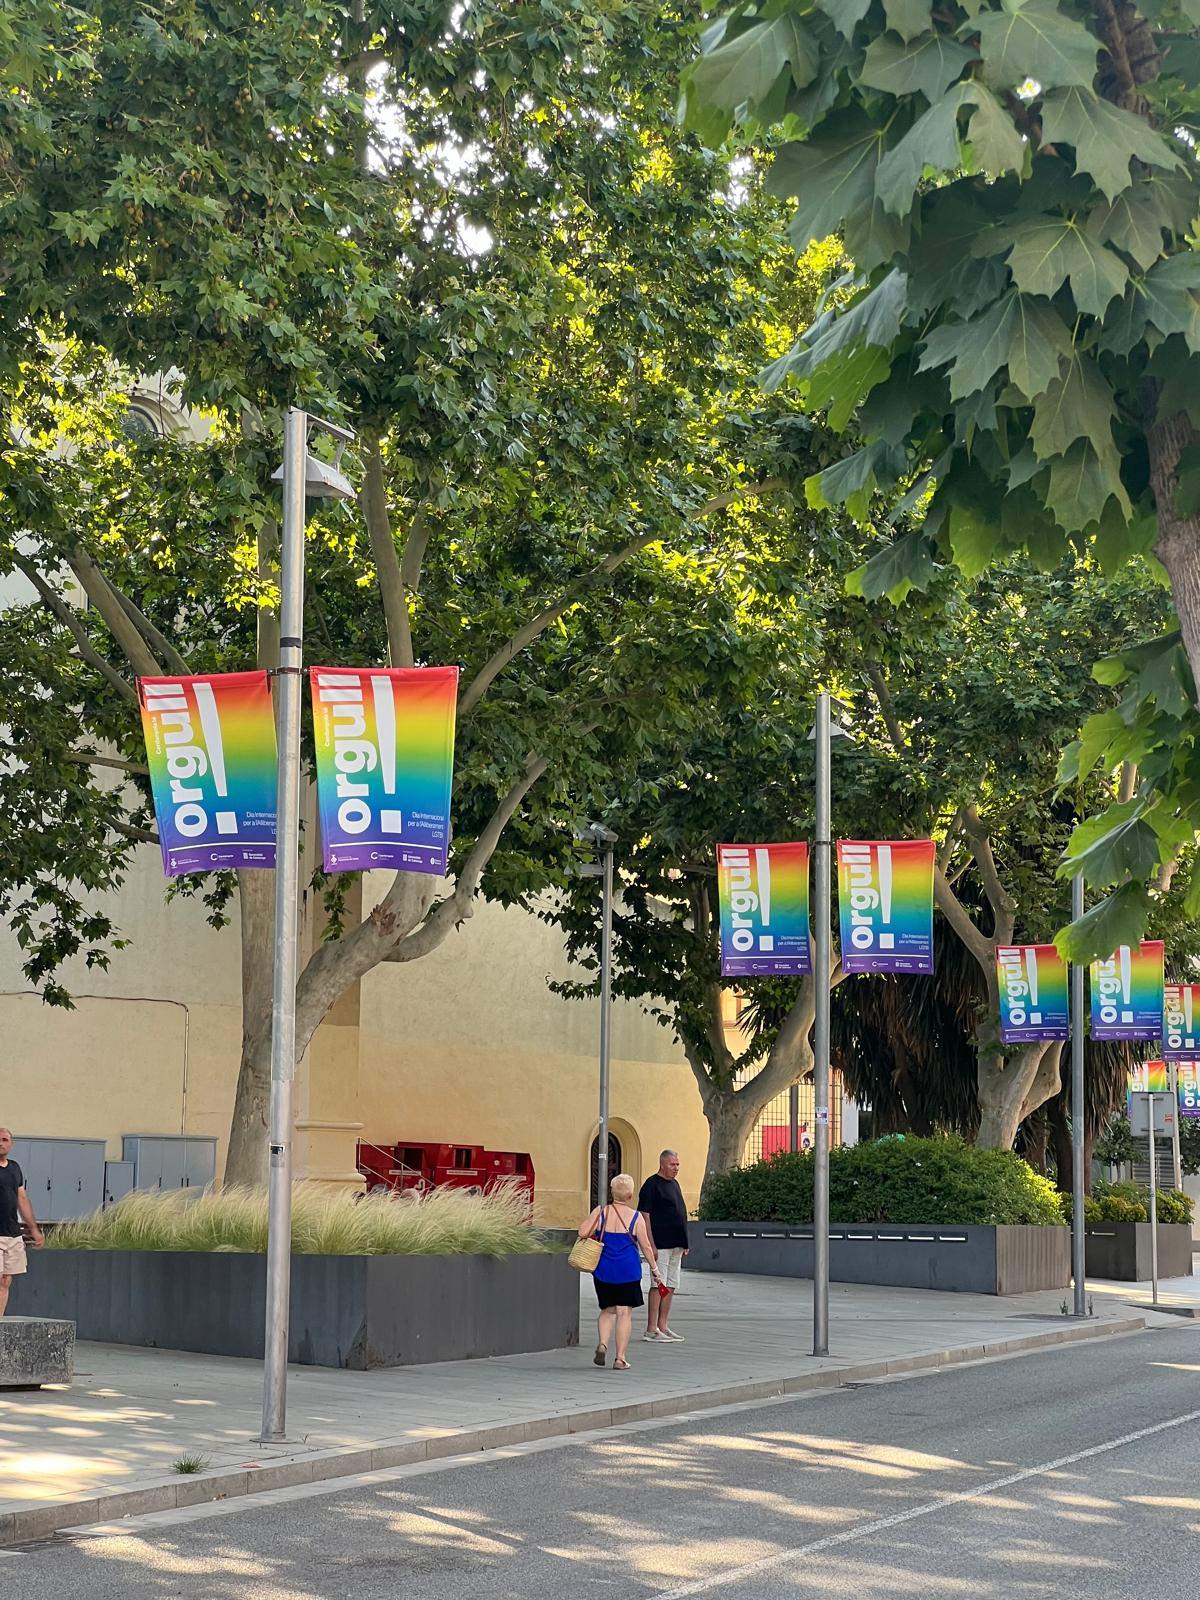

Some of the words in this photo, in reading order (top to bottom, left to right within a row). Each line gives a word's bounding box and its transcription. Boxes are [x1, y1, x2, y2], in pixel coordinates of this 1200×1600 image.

[143, 683, 208, 837] orgull
[317, 674, 377, 834] orgull
[721, 848, 759, 952] orgull
[841, 844, 880, 950] orgull
[998, 948, 1029, 1026] orgull
